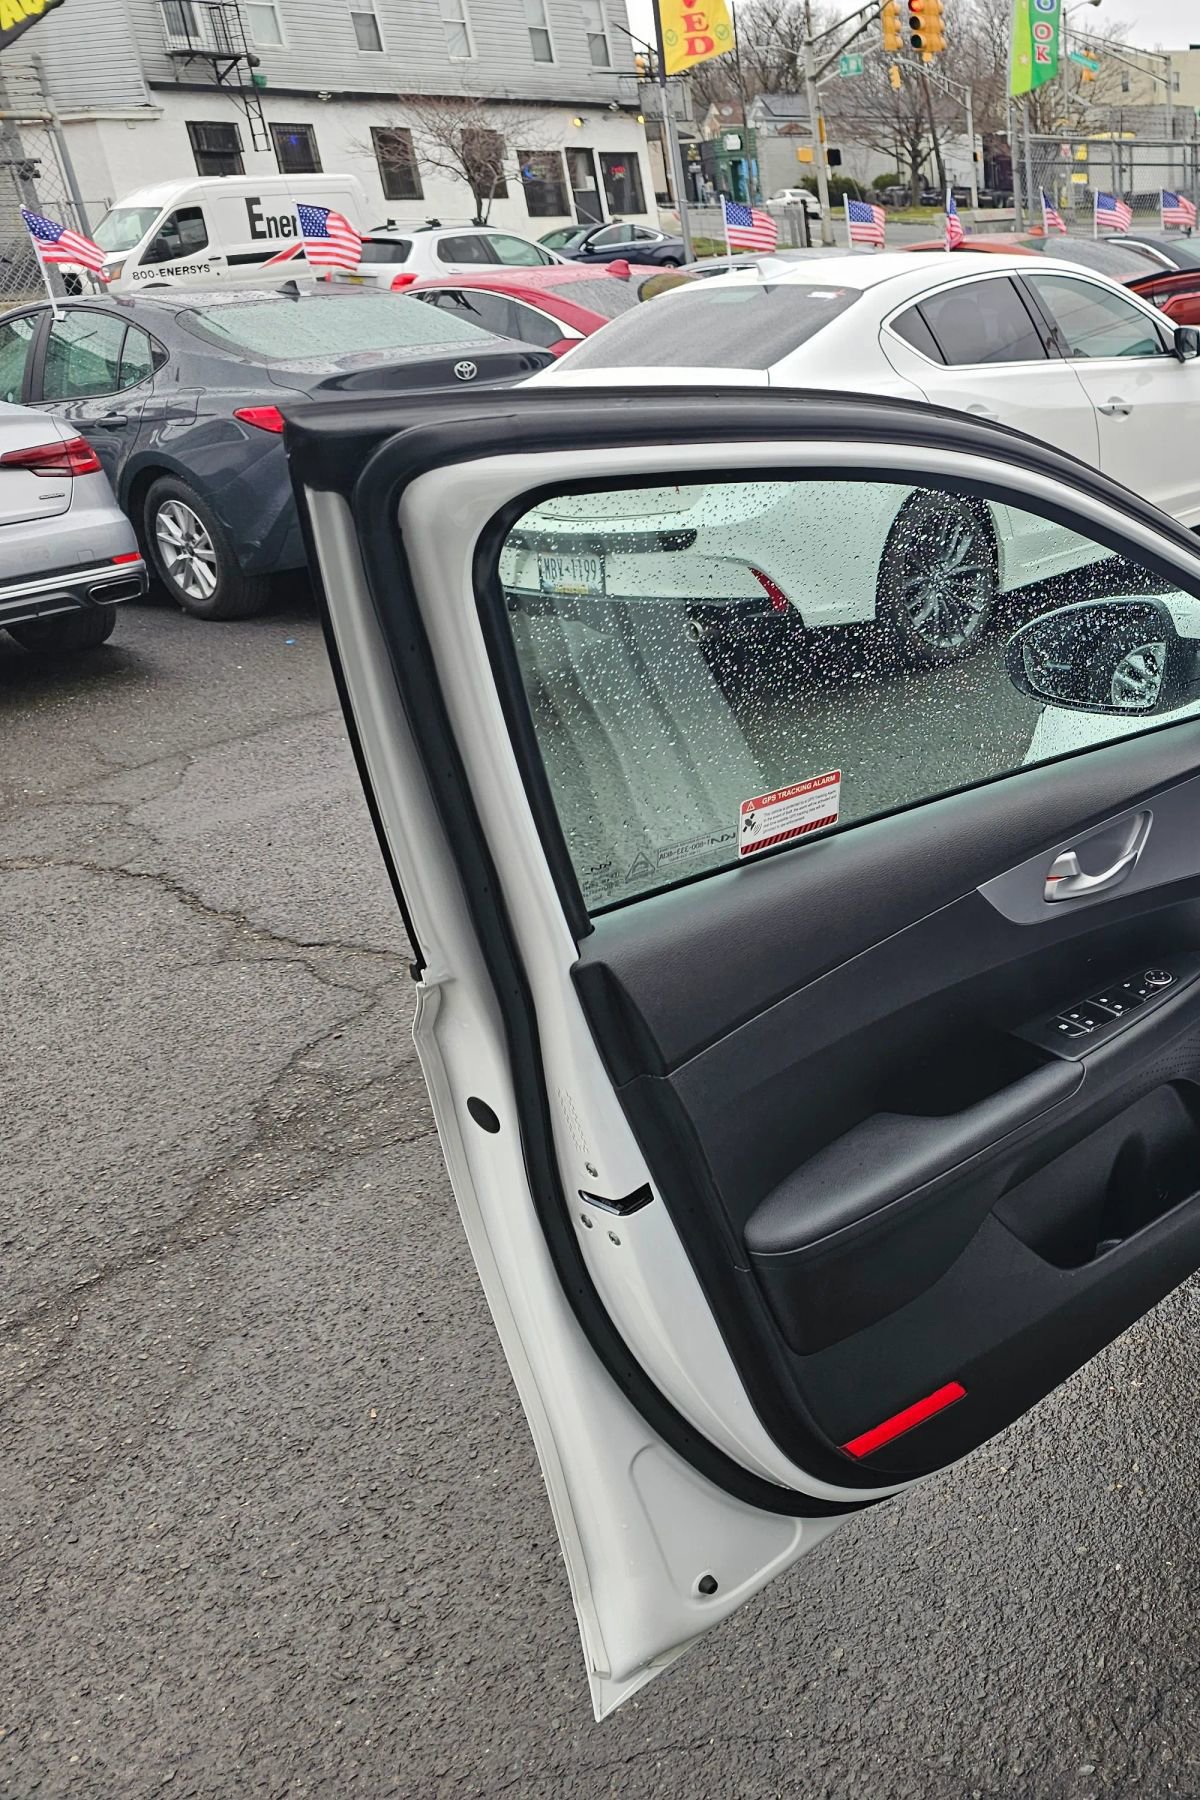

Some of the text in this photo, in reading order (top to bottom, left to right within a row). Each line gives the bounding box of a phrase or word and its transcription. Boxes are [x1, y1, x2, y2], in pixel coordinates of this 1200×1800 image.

[132, 264, 211, 281] 800-ENERSYS
[762, 775, 836, 805] GPS TRACKING ALARM
